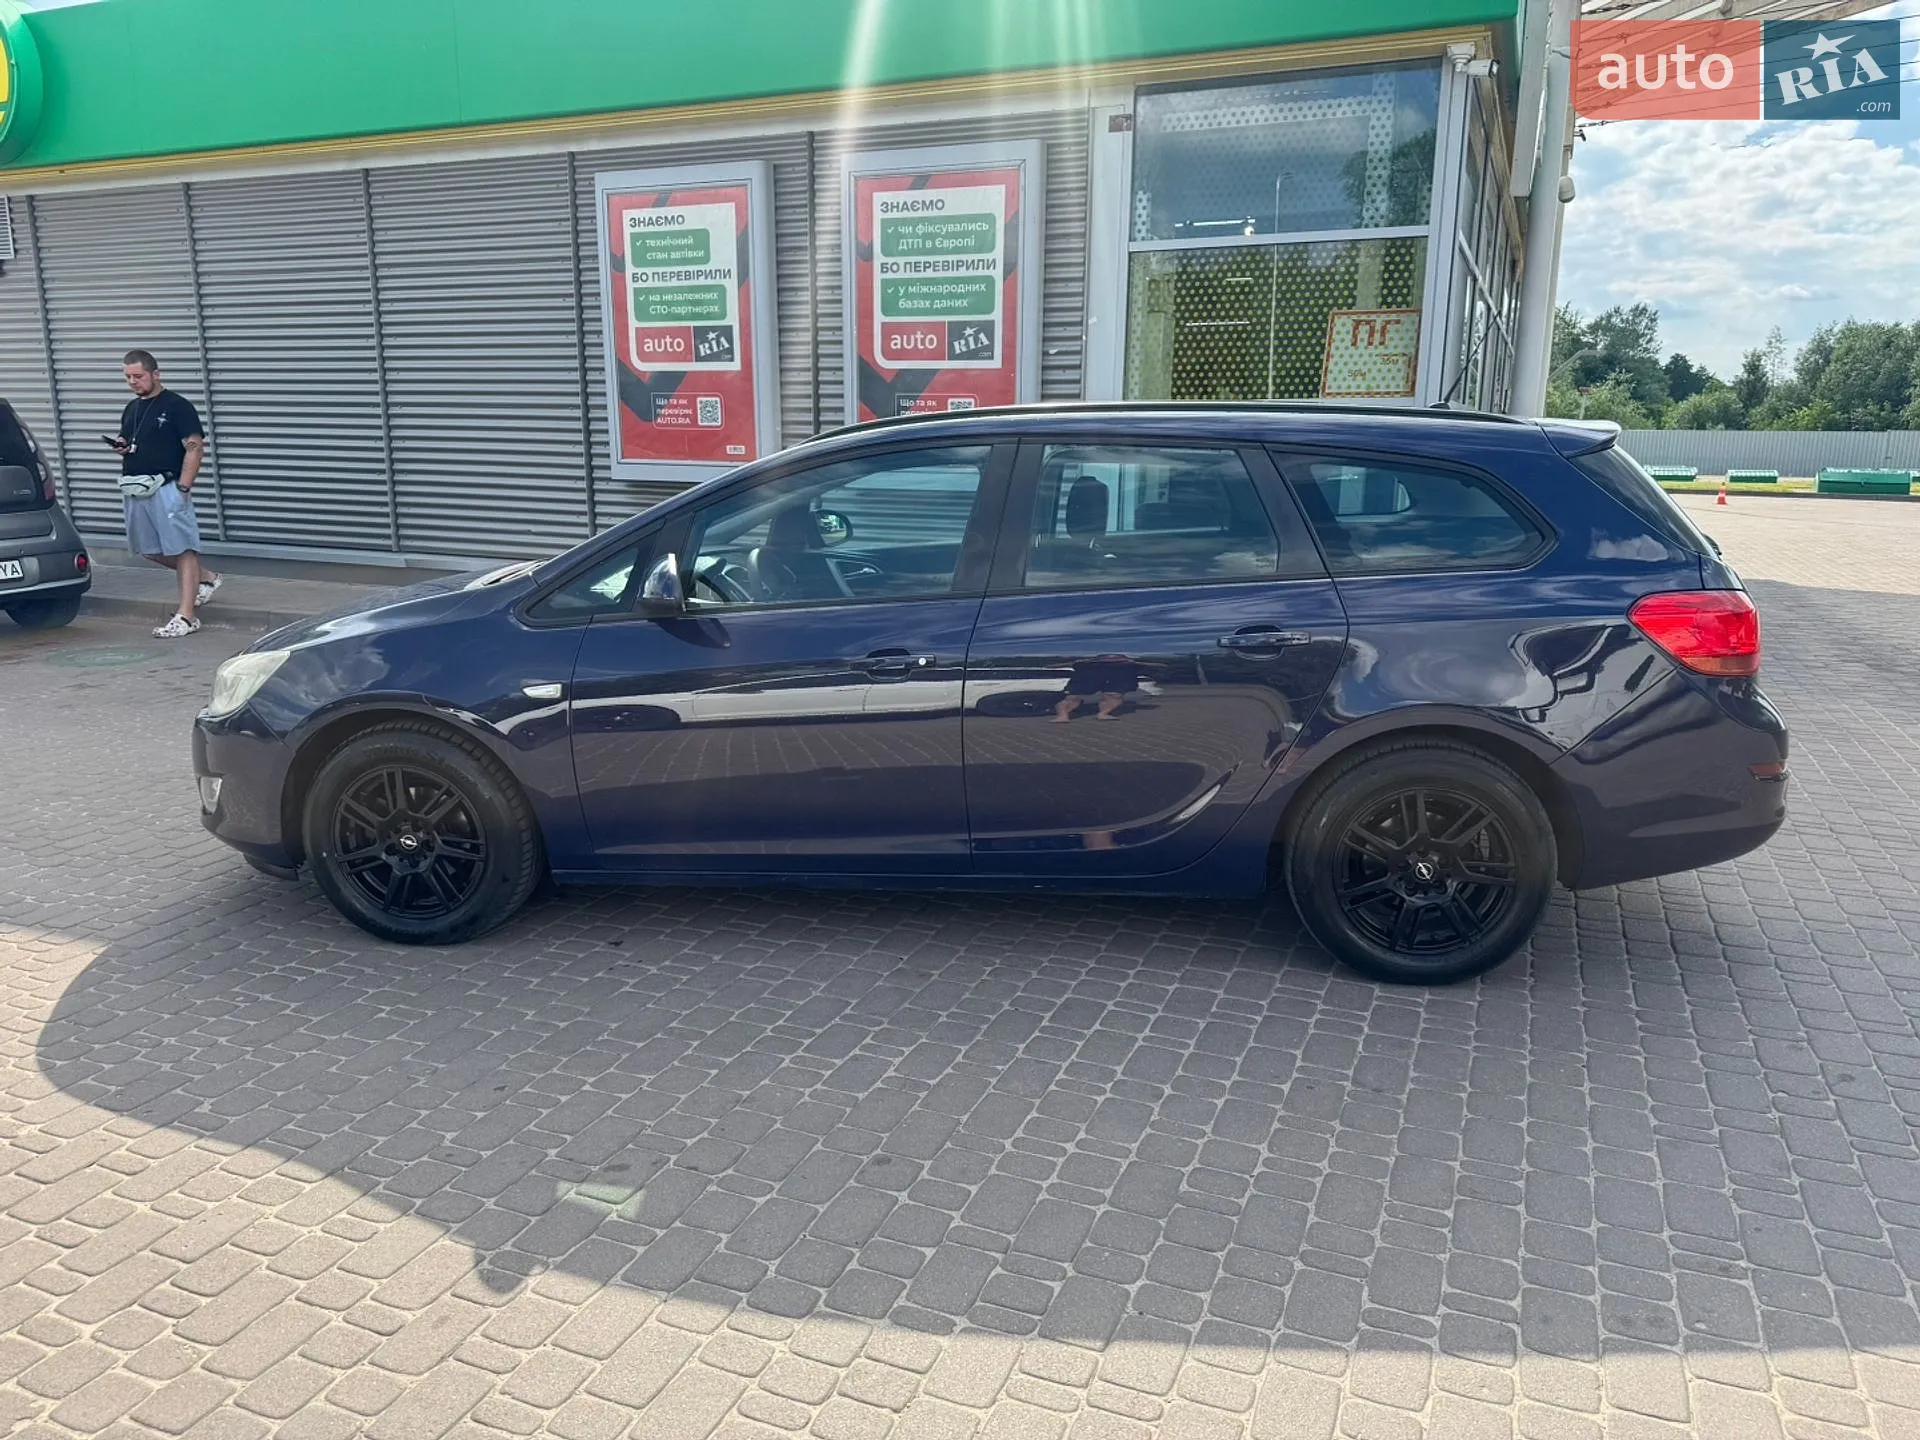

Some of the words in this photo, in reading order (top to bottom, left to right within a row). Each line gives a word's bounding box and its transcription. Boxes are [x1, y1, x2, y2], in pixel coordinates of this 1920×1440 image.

[880, 199, 945, 213] ЗНАЄМО
[629, 214, 685, 229] ЗНАЄМО
[898, 226, 912, 235] чи
[915, 222, 989, 236] фіксувались
[645, 235, 693, 248] технічний
[898, 239, 922, 251] ДТП
[926, 240, 932, 249] в
[935, 235, 975, 250] Європі
[646, 251, 668, 261] стан
[670, 248, 704, 260] автівки
[880, 261, 900, 274] БО
[903, 258, 997, 273] ПЕРЕВІРИЛИ
[632, 272, 649, 284] БО
[652, 267, 732, 283] ПЕРЕВІРИЛИ
[898, 285, 905, 296] у
[908, 282, 987, 295] міжнародних
[649, 294, 660, 303] на
[662, 292, 719, 302] незалежних
[898, 298, 931, 310] базах
[933, 298, 968, 310] даних
[649, 304, 720, 317] СТО-партнерах
[643, 334, 685, 352] auto
[698, 336, 730, 357] RIA
[890, 330, 937, 350] auto
[953, 332, 990, 355] RIA
